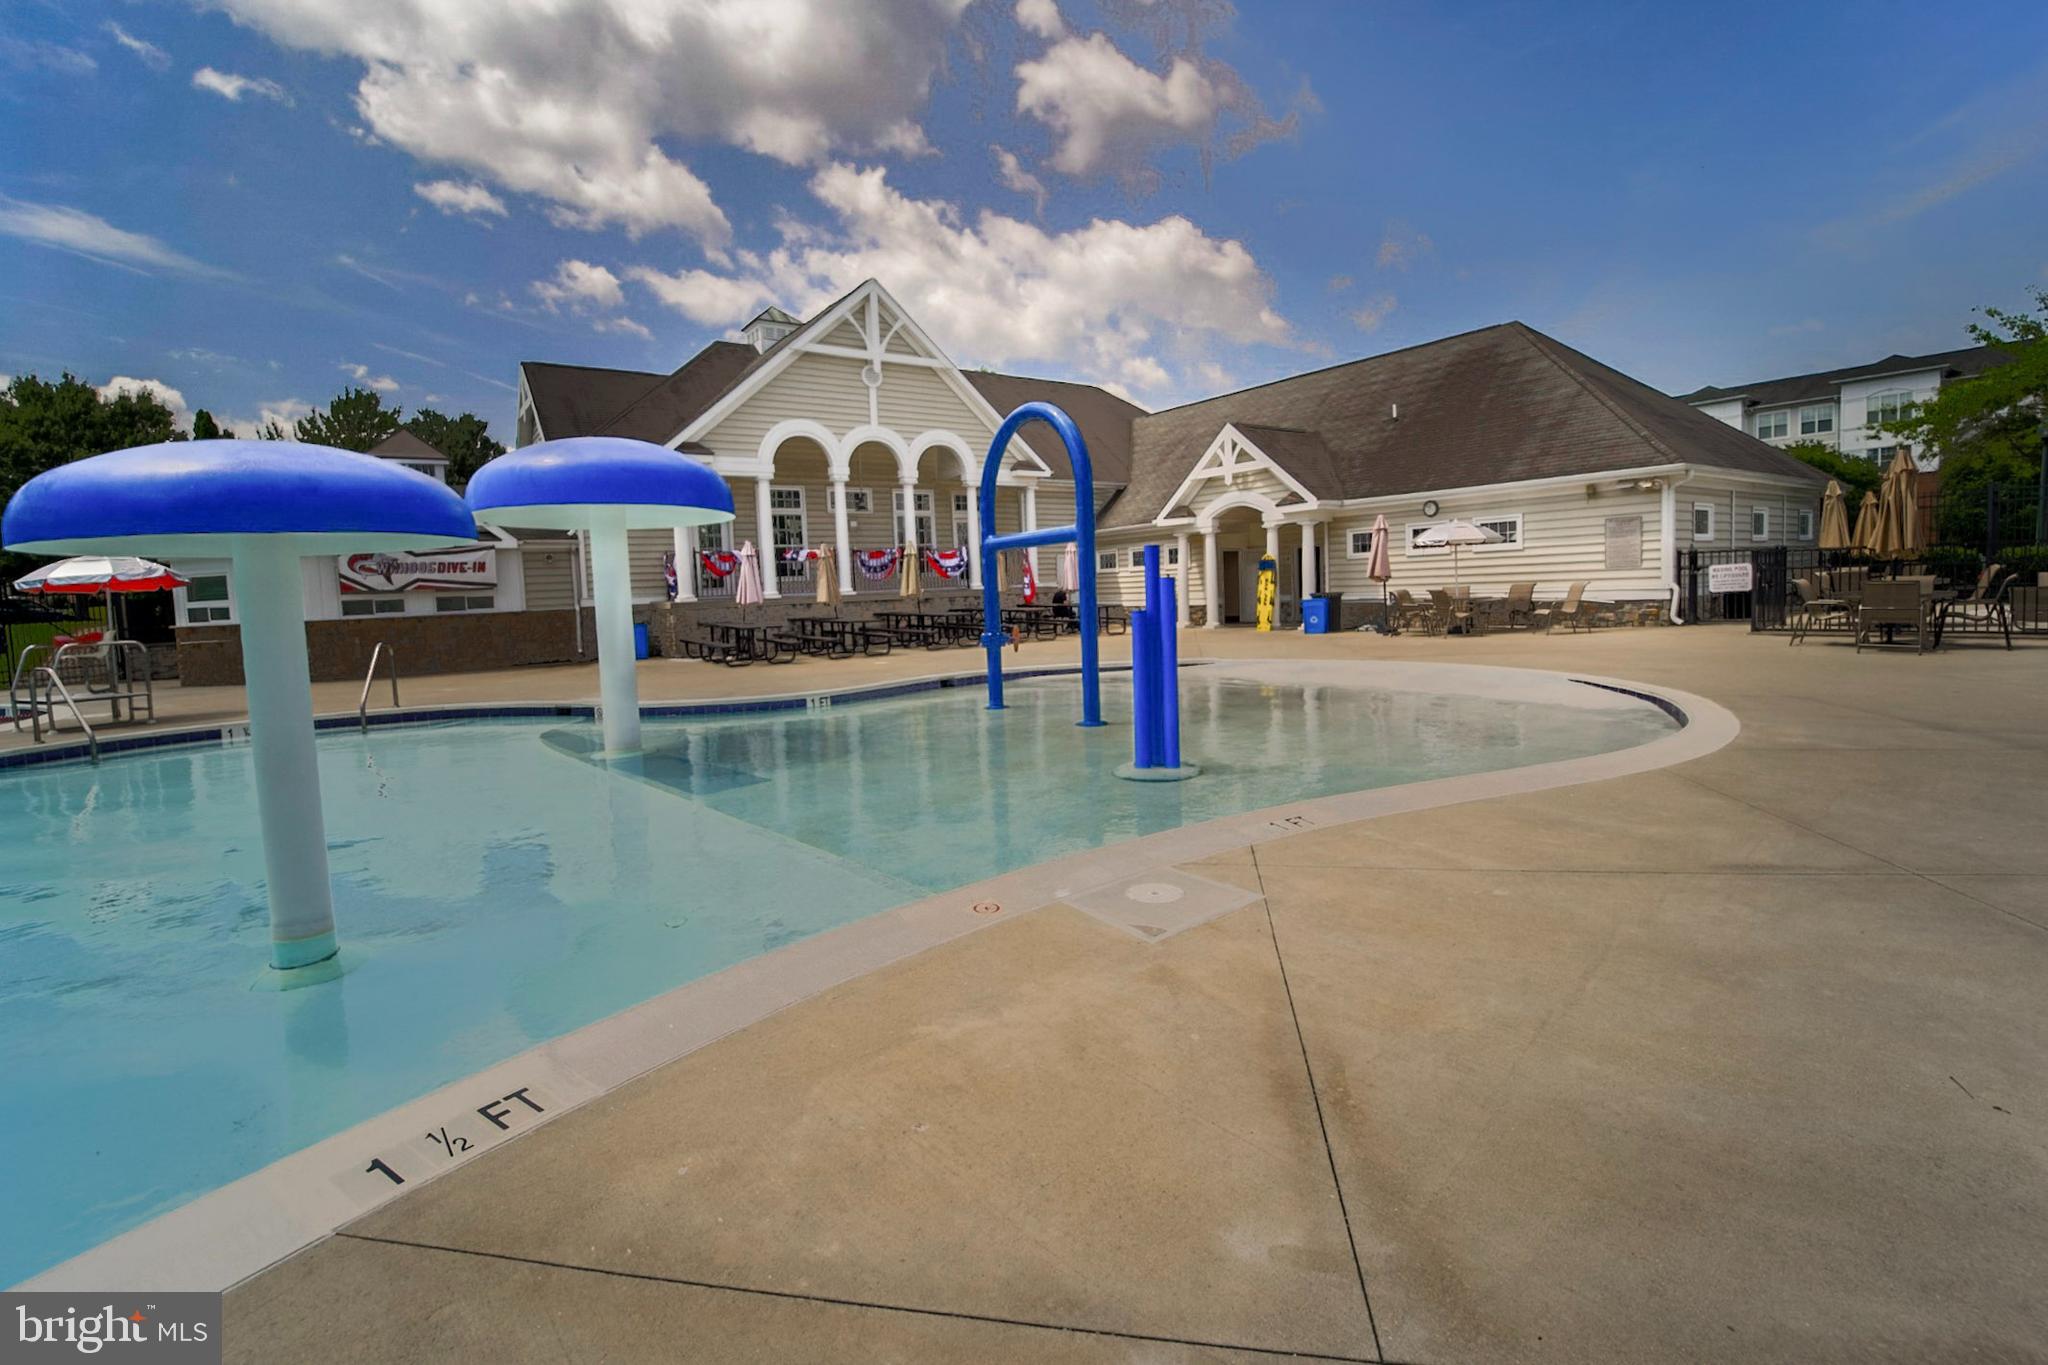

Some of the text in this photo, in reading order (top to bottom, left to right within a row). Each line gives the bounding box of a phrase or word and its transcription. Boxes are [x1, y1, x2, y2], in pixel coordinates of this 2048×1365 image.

[437, 561, 486, 574] DIVE-IN
[365, 1157, 405, 1185] 1
[476, 1087, 545, 1131] FT
